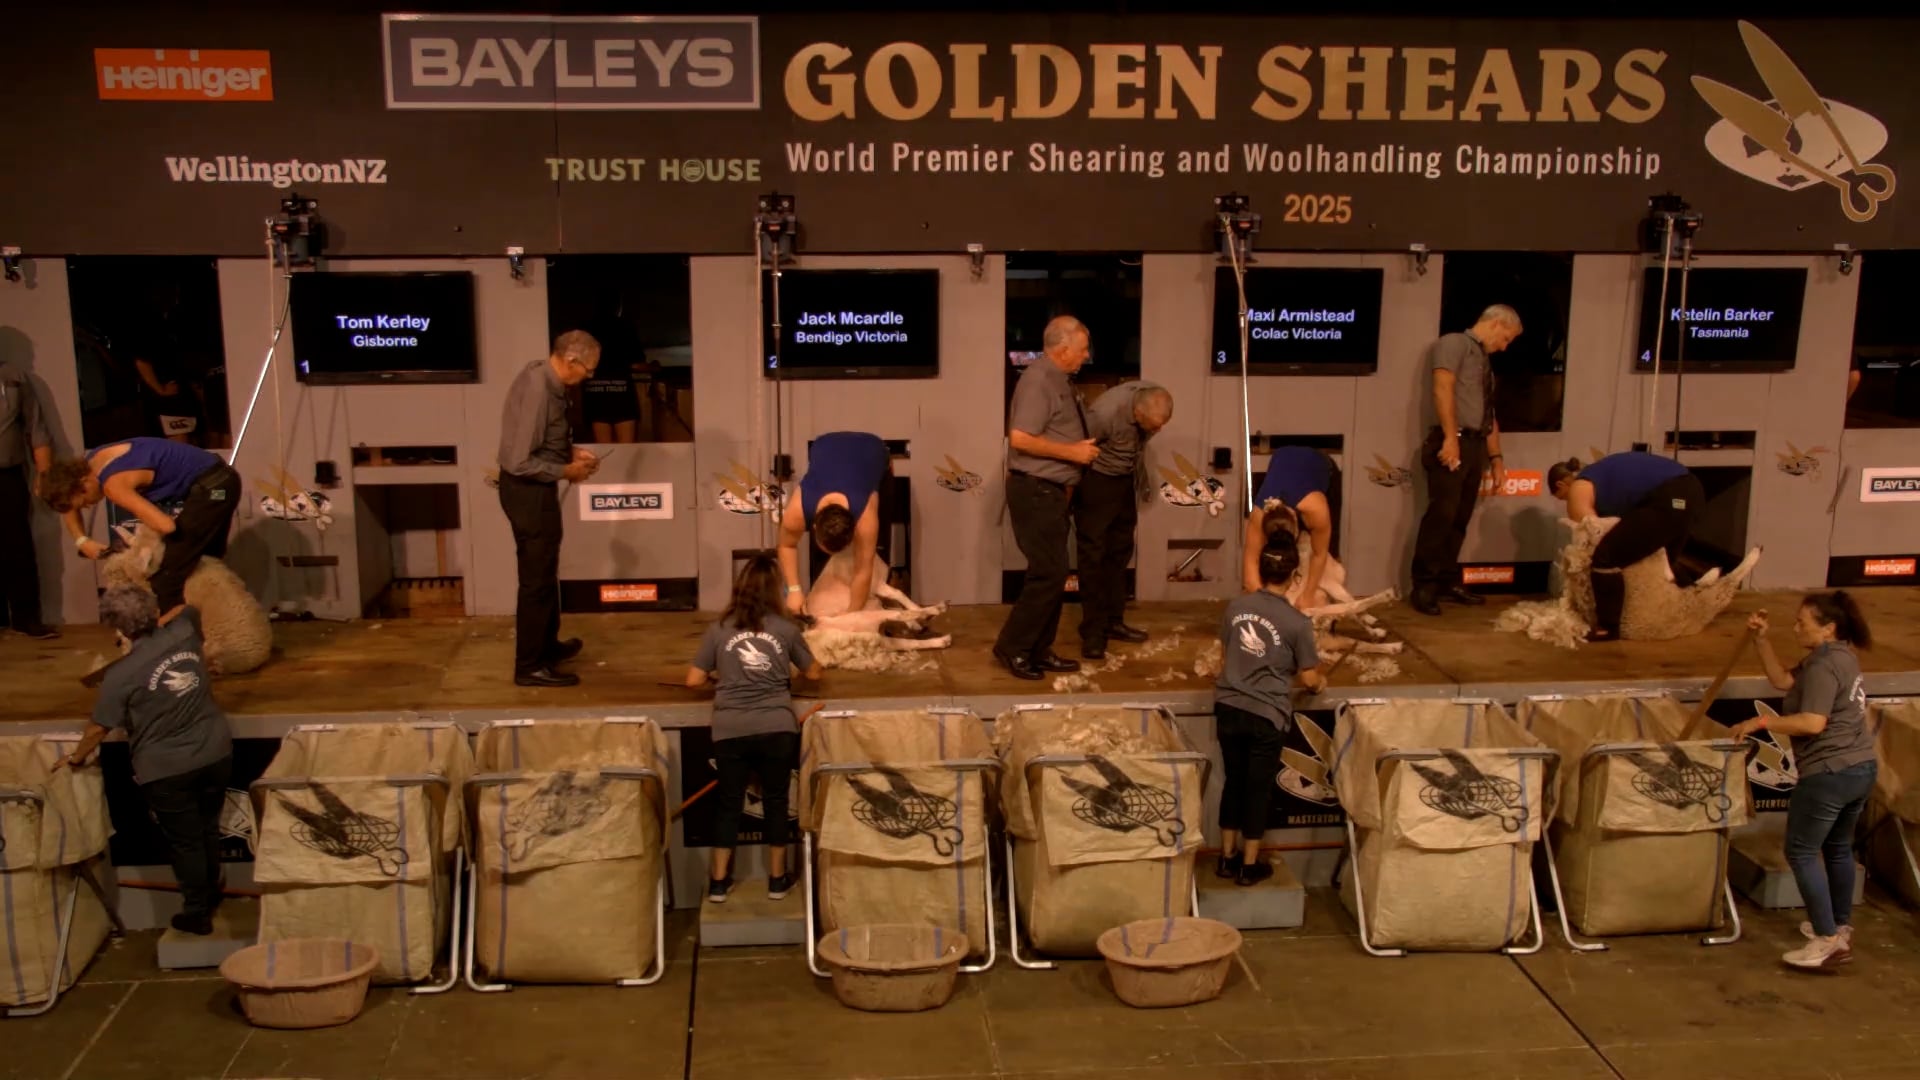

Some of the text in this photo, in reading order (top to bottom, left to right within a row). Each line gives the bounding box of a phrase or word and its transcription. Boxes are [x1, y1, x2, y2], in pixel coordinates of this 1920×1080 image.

[410, 37, 734, 88] BAYLEYS
[103, 49, 267, 97] Heiniger
[784, 42, 1668, 124] GOLDEN SHEARS
[786, 142, 1660, 180] World Premier Shearing and Woolhandling Championship
[165, 155, 387, 189] WellingtonNZ
[545, 158, 761, 183] TRUST HOUSE
[1284, 193, 1352, 224] 2025
[798, 311, 904, 325] Jack Mcardle
[1278, 308, 1355, 322] Armistead
[1724, 308, 1775, 321] Barker
[336, 314, 430, 331] Tom Kerley
[796, 331, 908, 345] Bendigo Victoria
[1251, 327, 1342, 340] Colac Victoria
[1690, 326, 1749, 338] Tasmania
[353, 335, 418, 347] Gisborne
[768, 355, 778, 369] 2
[1217, 350, 1226, 364] 3
[1641, 349, 1651, 362] 4
[299, 360, 310, 374] 1
[594, 496, 659, 508] BAYLEYS
